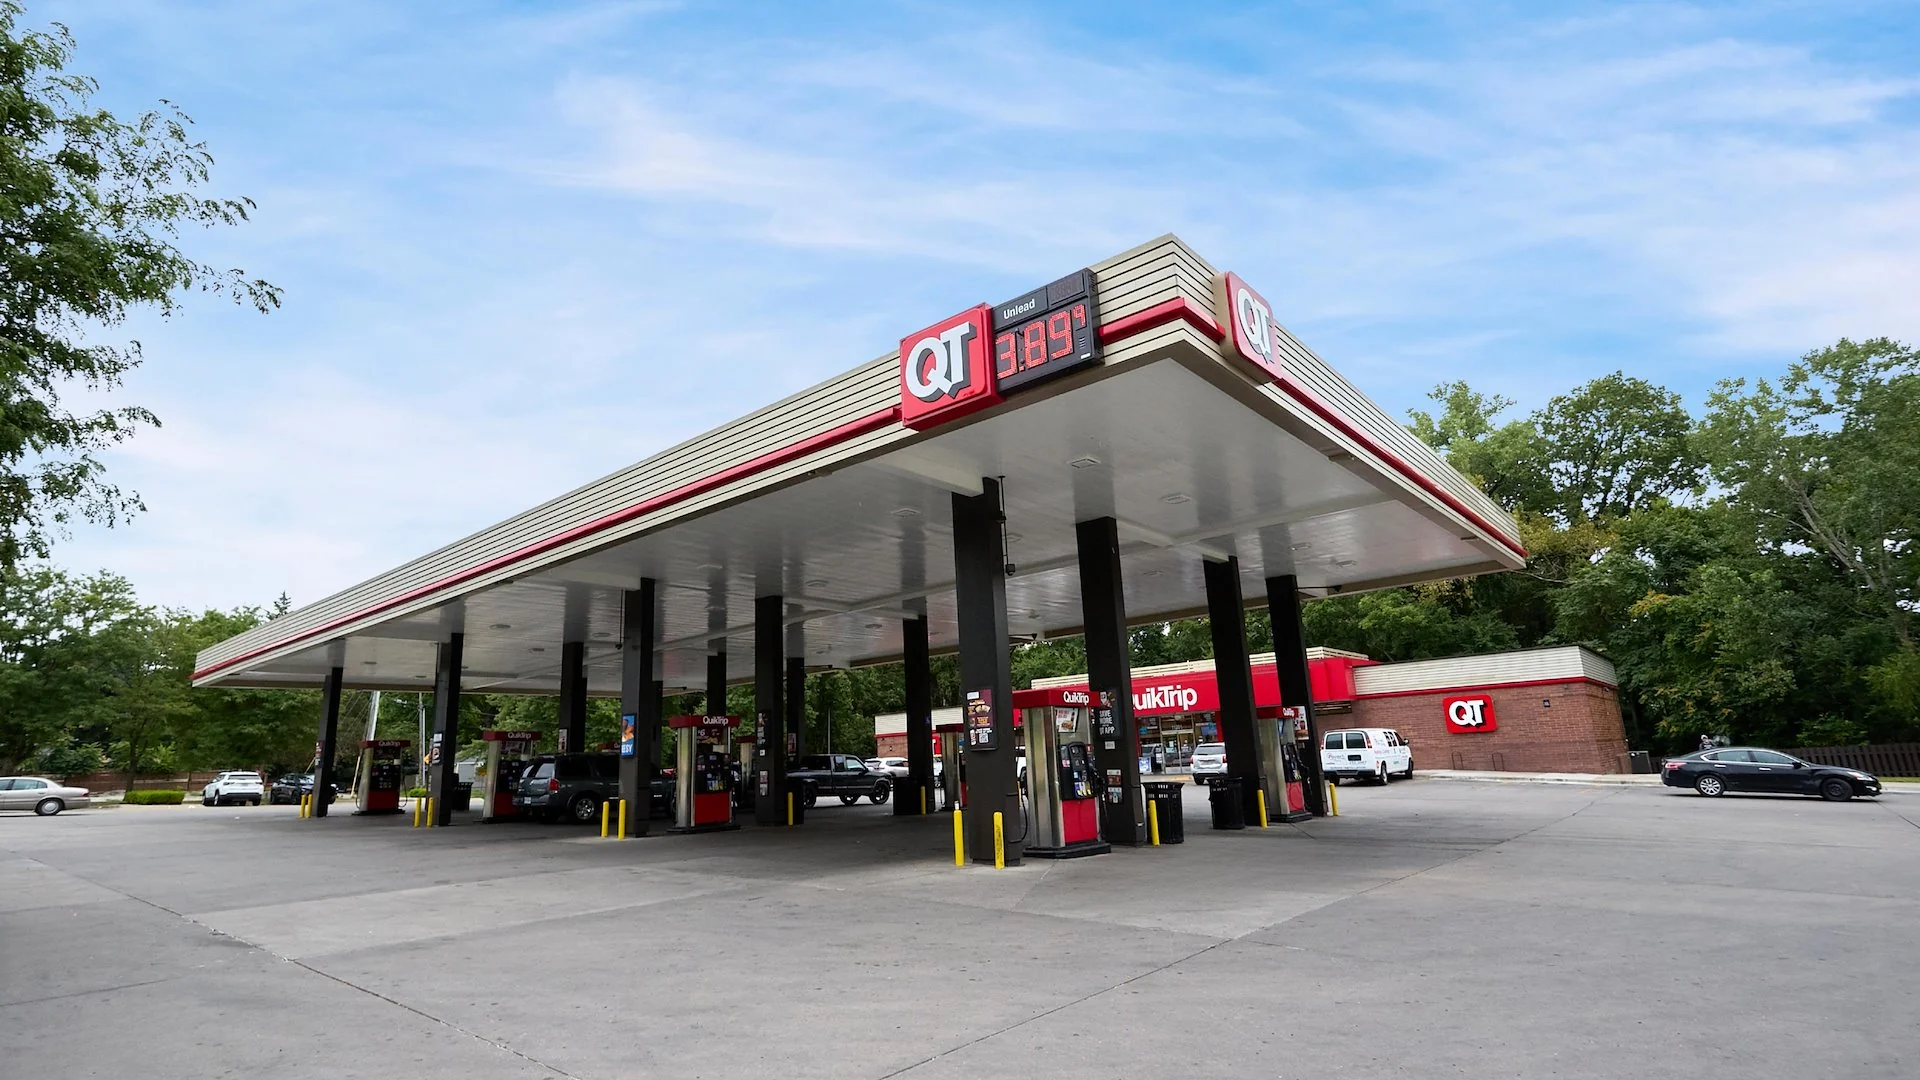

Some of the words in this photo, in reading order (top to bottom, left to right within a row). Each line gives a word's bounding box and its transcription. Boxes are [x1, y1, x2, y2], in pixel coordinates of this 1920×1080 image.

[1004, 299, 1036, 320] Unlead
[1238, 288, 1272, 355] QT
[906, 321, 972, 399] QT
[1063, 691, 1090, 706] QuikTrip
[1132, 684, 1198, 711] uikTrip
[1448, 700, 1485, 727] QT
